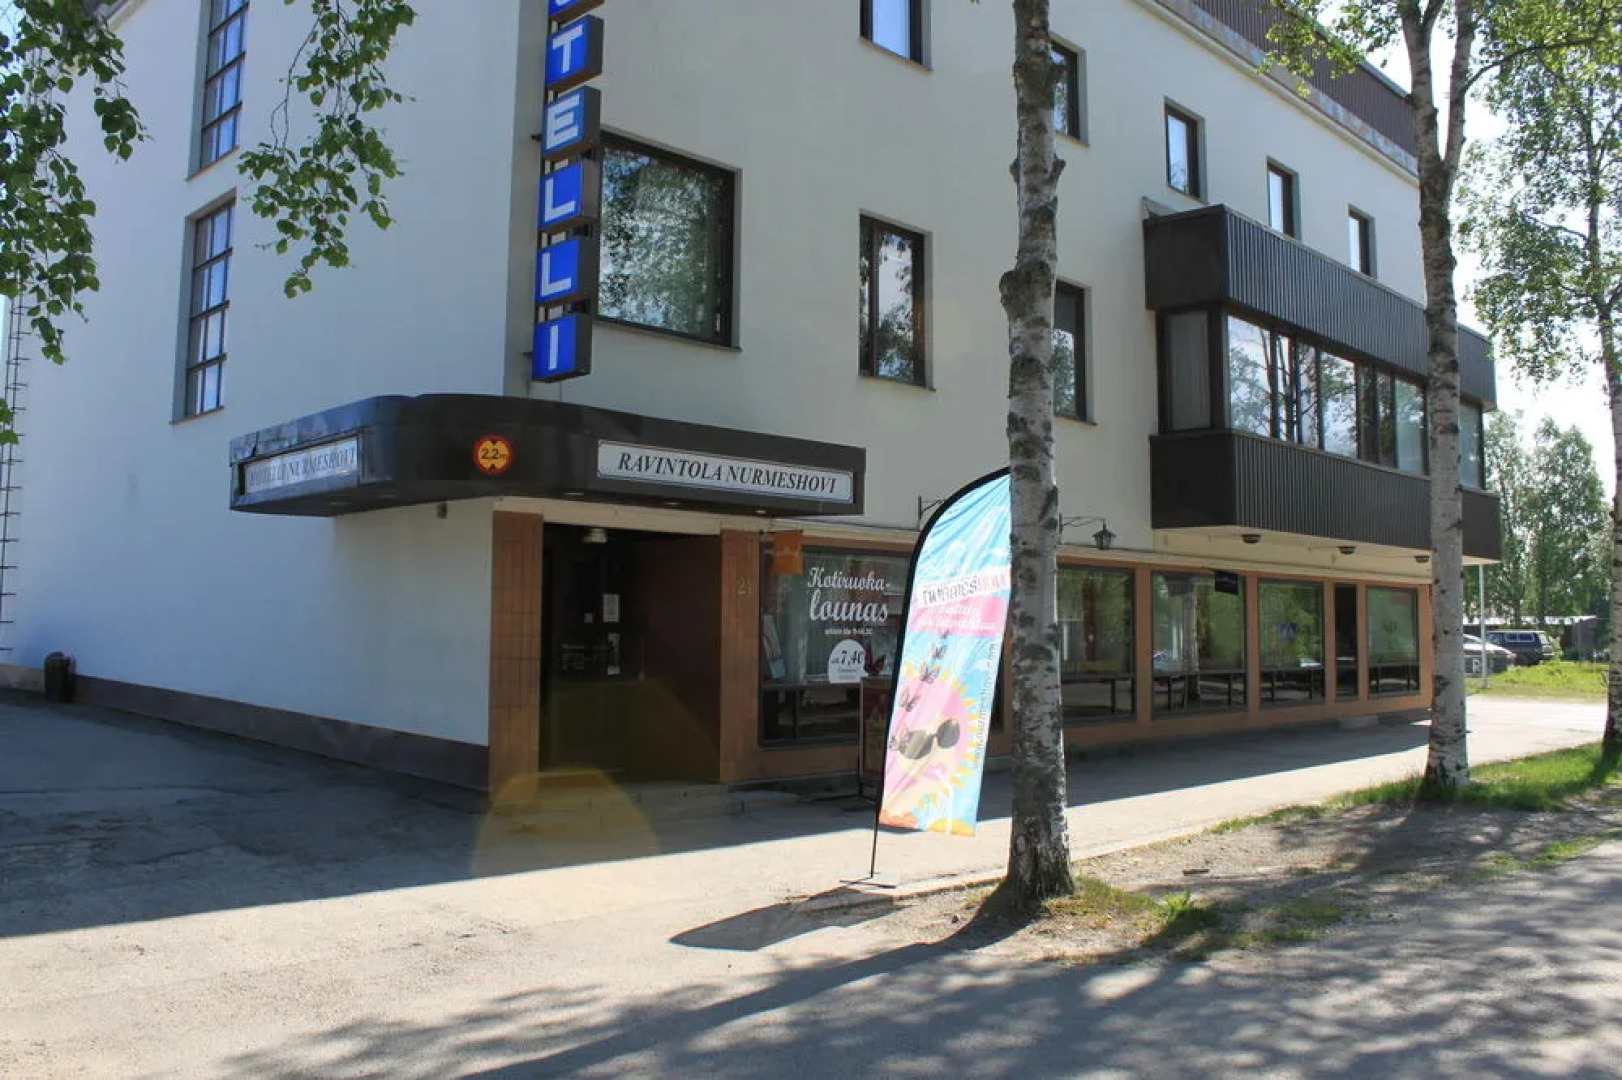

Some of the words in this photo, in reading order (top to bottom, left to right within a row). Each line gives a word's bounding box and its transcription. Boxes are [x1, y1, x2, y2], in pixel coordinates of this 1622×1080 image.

[541, 0, 584, 371] TELLI
[617, 452, 722, 482] RAVINTOLA
[725, 465, 838, 495] NURMESHOVI
[807, 566, 890, 591] Kotiruoka-
[809, 588, 888, 623] lounas
